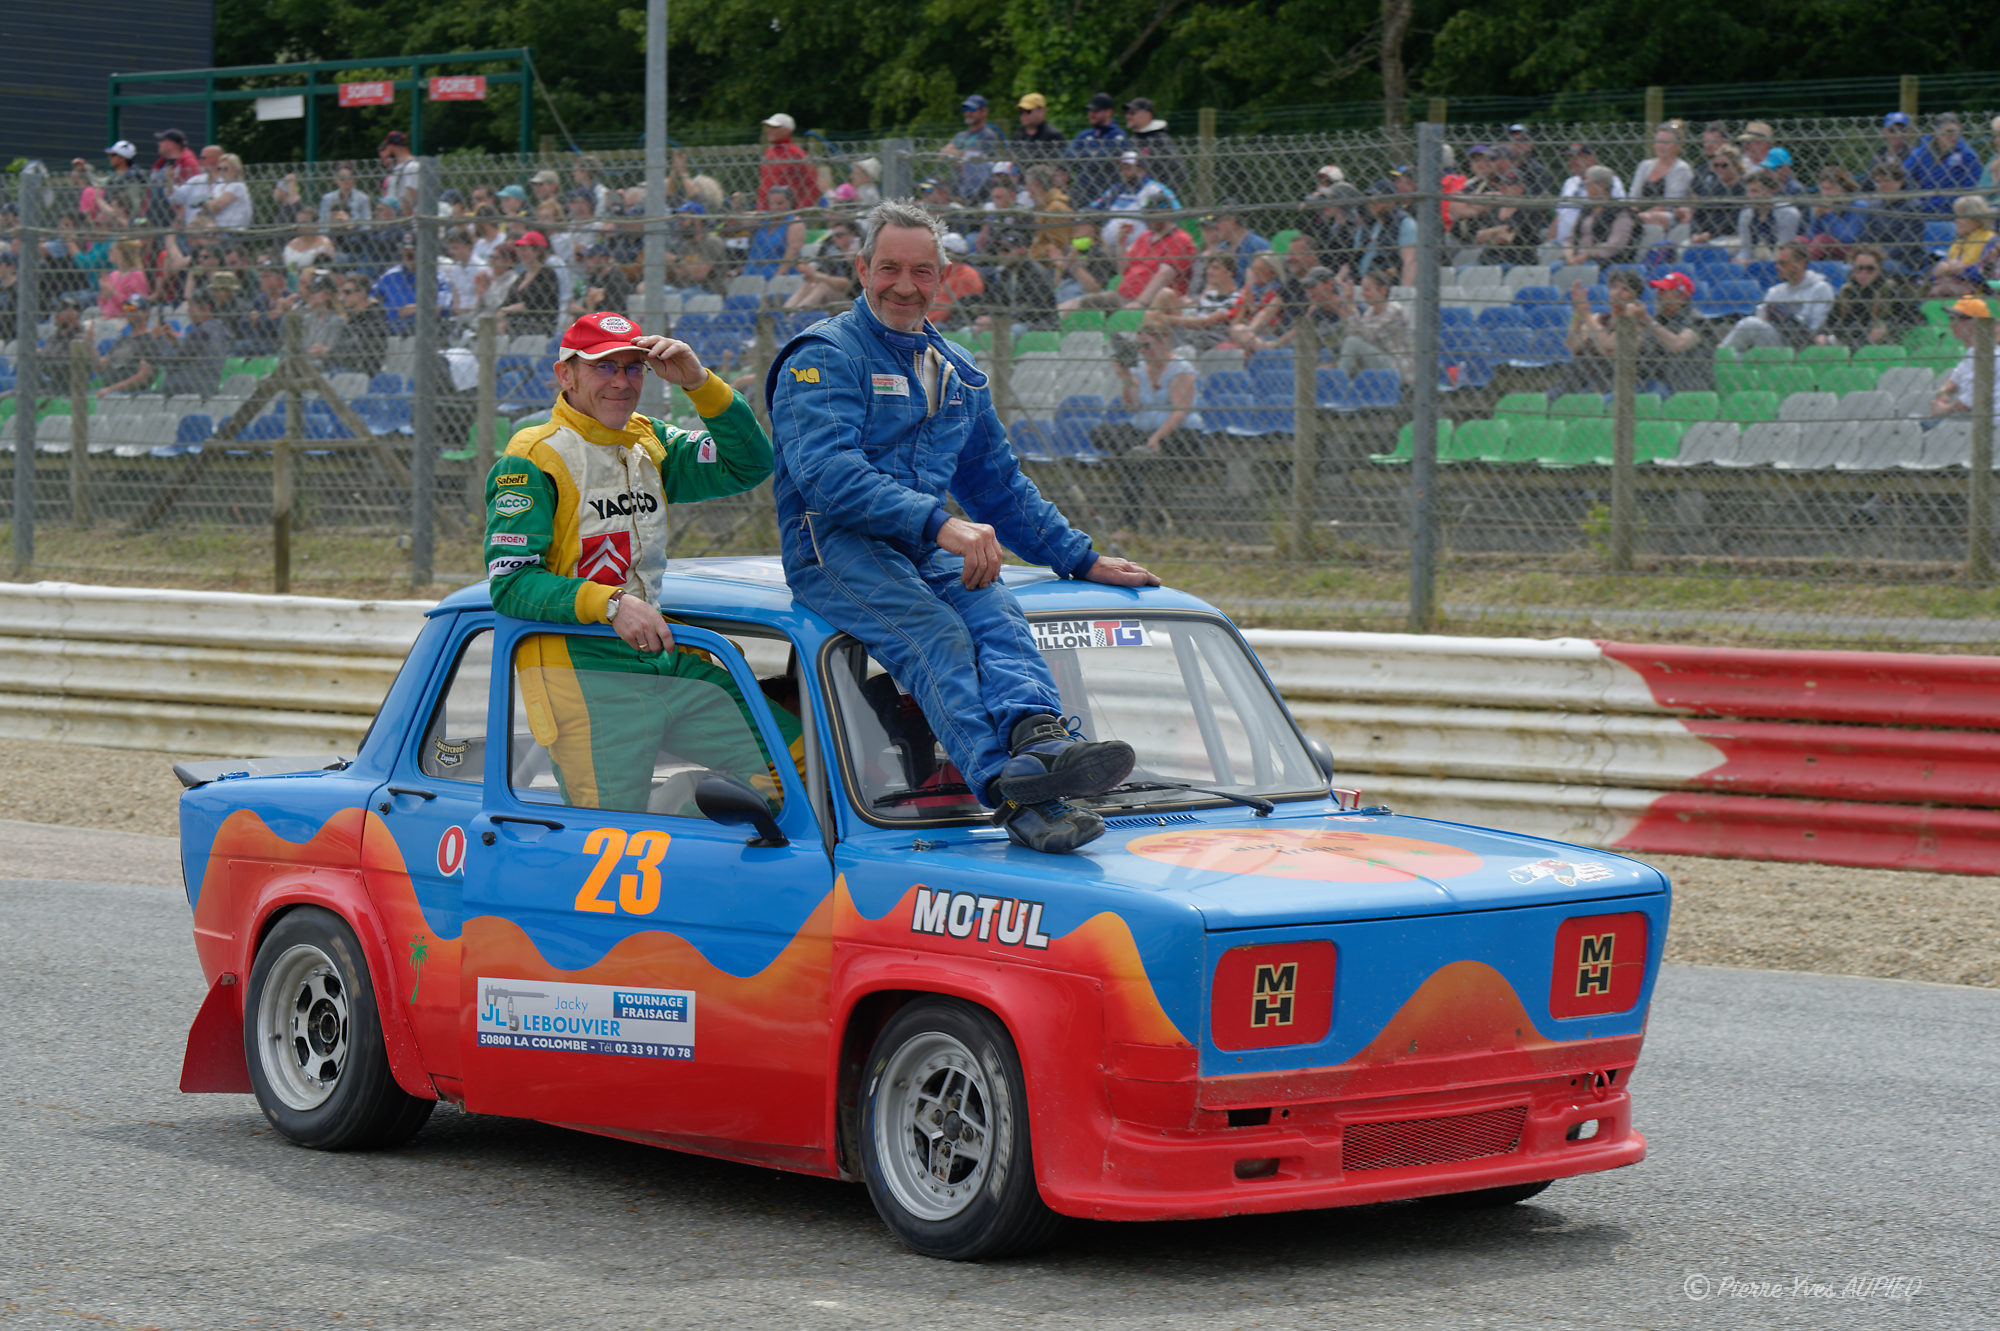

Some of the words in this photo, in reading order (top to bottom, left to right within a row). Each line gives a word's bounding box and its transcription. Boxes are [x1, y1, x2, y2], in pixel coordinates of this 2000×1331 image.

[347, 83, 384, 98] SORTIE
[438, 78, 475, 93] SORTIE
[497, 475, 525, 484] Sabelt
[1034, 622, 1090, 635] TEAM
[1093, 620, 1143, 646] TG
[1037, 635, 1091, 649] ILLON
[437, 741, 465, 753] RALLYCROSS
[574, 828, 672, 915] 23
[911, 886, 1050, 950] MOTUL
[555, 996, 588, 1014] Jacky
[618, 994, 684, 1008] TOURNAGE
[622, 1007, 679, 1020] FRAISAGE
[523, 1015, 621, 1037] LEBOUVIER
[481, 1034, 511, 1045] 50800
[514, 1036, 529, 1047] LA
[532, 1038, 588, 1051] COLOMBE
[598, 1042, 614, 1053] Tél.
[615, 1043, 628, 1054] 02
[631, 1044, 643, 1055] 33
[646, 1045, 658, 1056] 91
[662, 1046, 675, 1057] 70
[677, 1047, 691, 1058] 78
